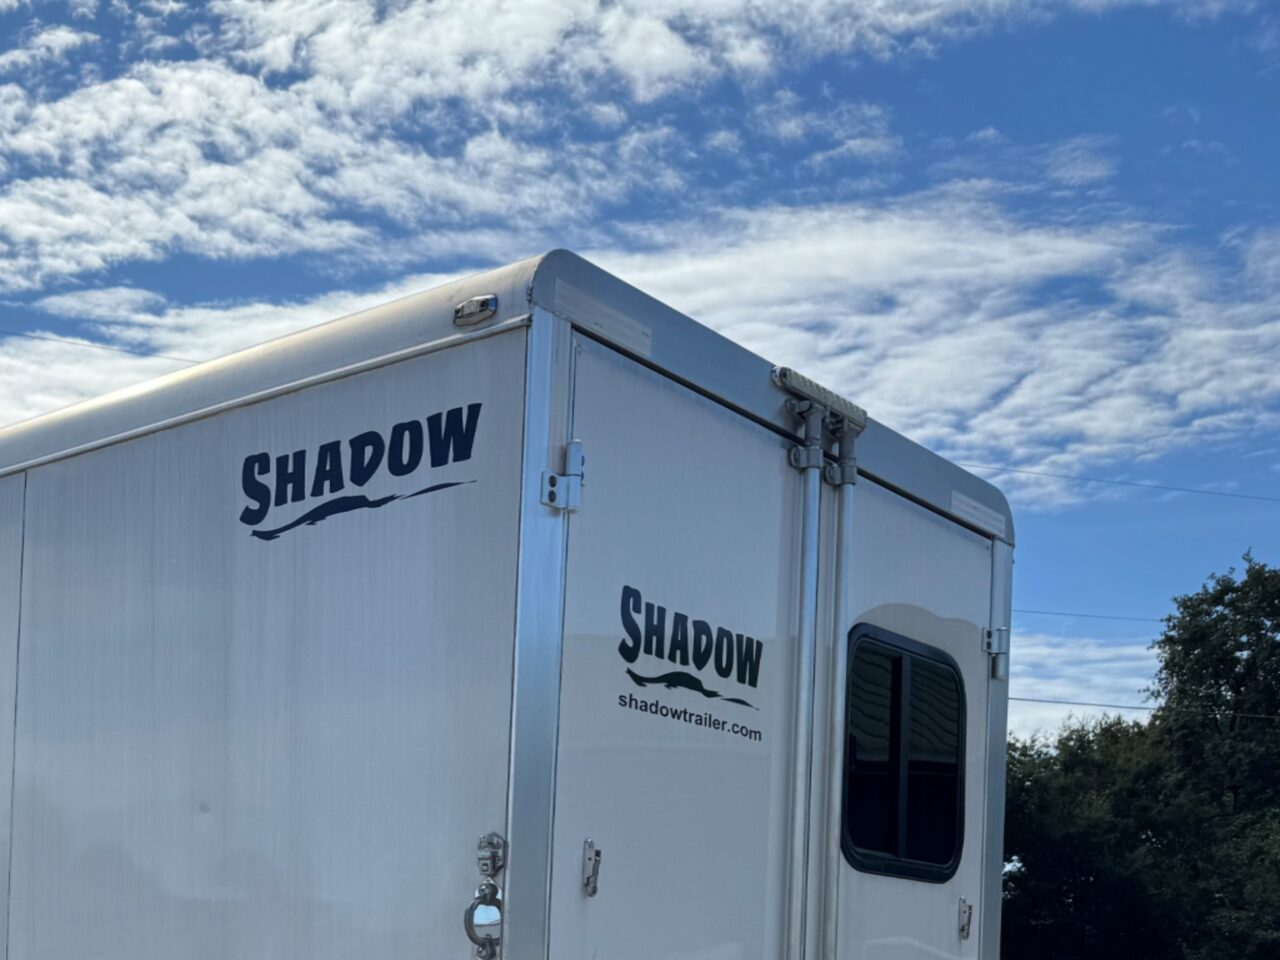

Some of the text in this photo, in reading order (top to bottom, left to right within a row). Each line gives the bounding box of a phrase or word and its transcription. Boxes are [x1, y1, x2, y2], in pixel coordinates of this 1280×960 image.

[239, 402, 482, 526] SHADOW
[618, 585, 763, 688] SHADOW
[618, 693, 762, 742] shadowtrailer.com
